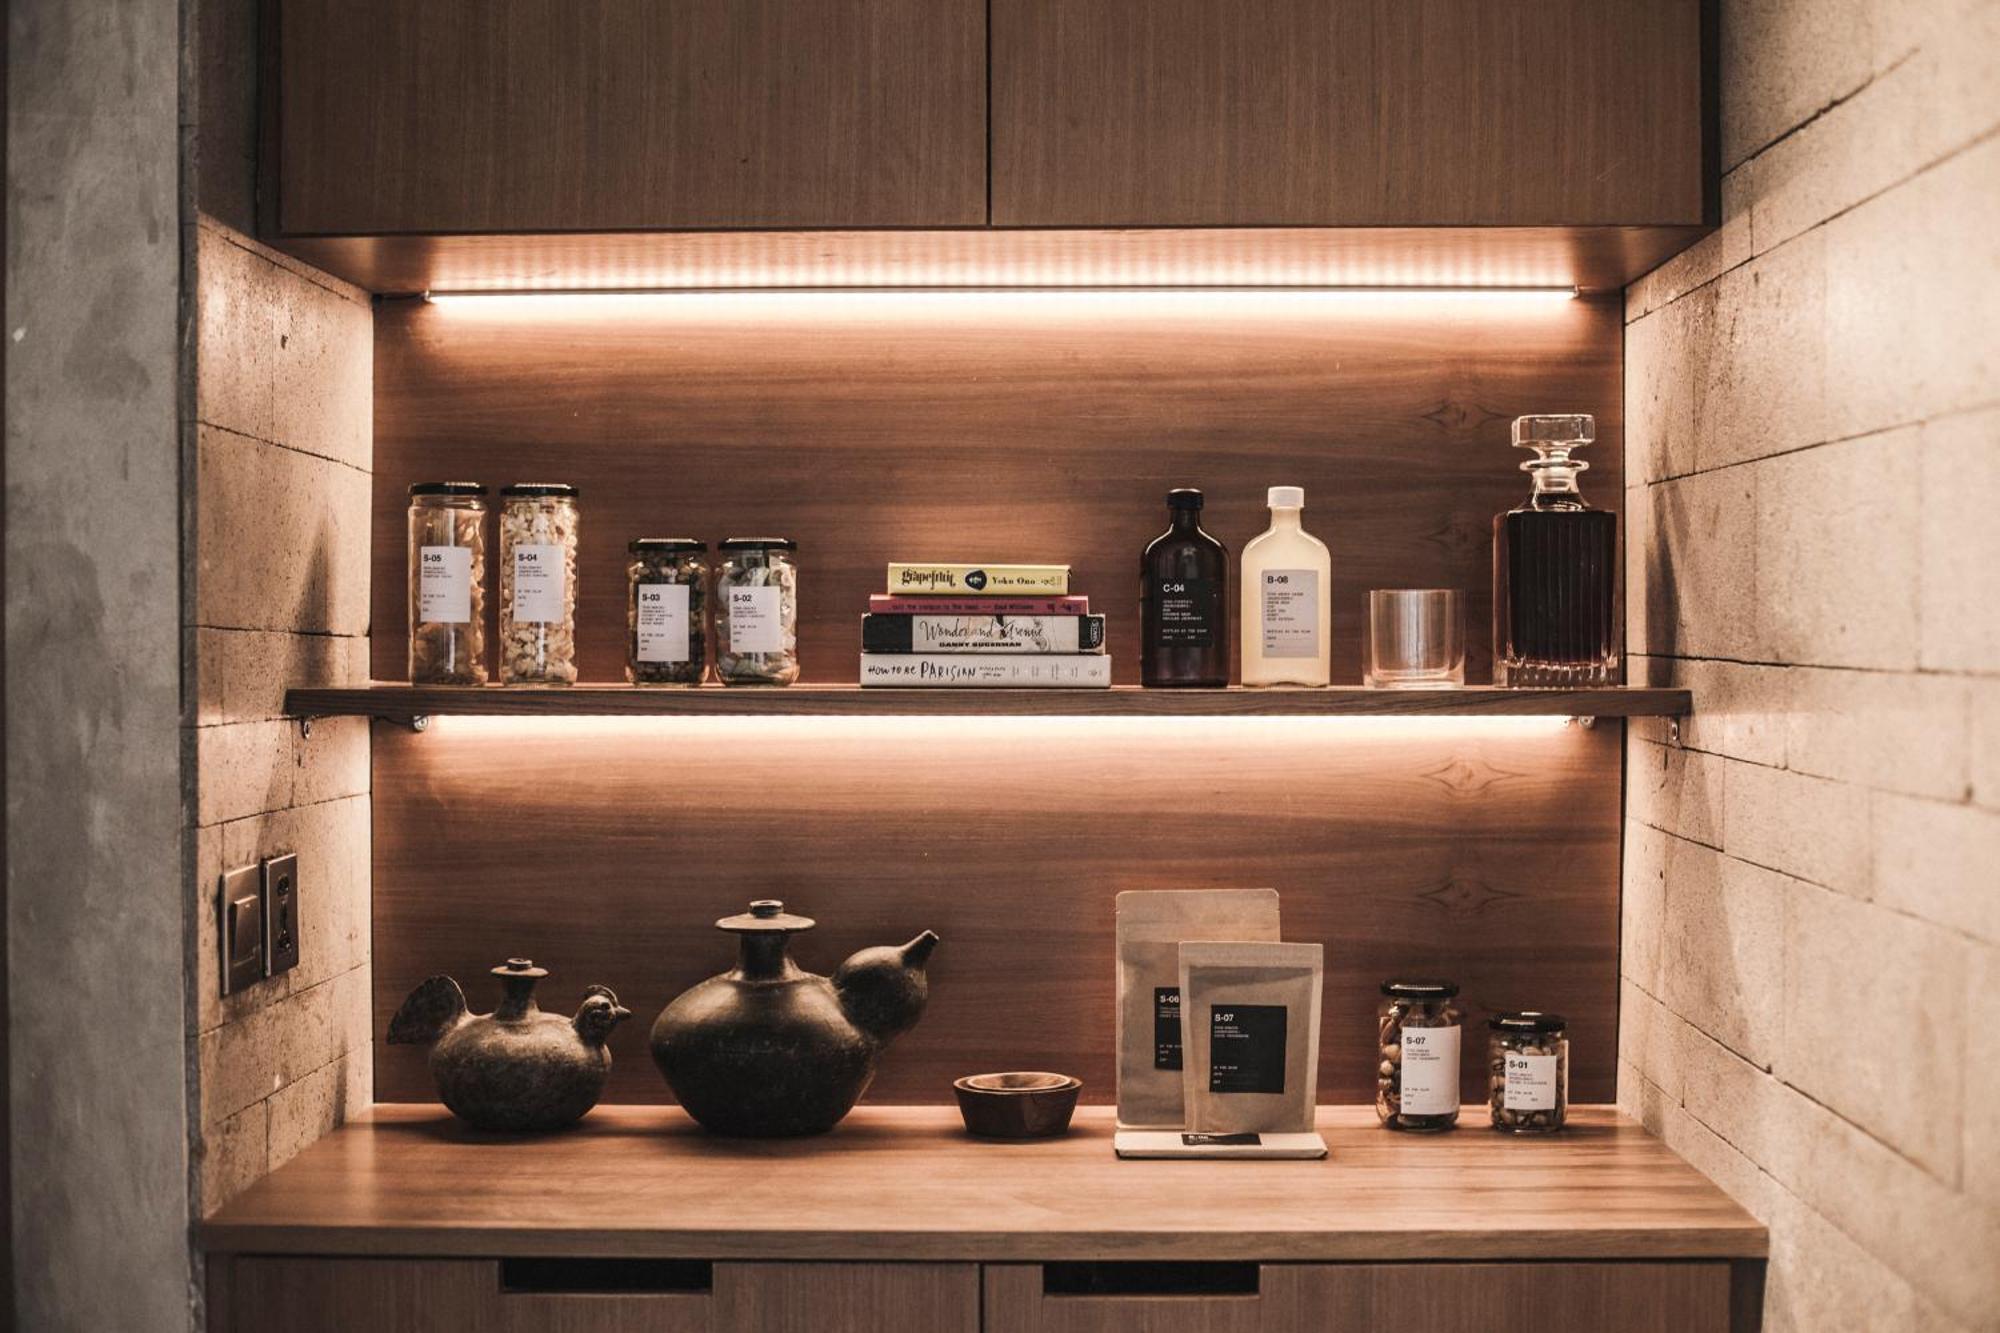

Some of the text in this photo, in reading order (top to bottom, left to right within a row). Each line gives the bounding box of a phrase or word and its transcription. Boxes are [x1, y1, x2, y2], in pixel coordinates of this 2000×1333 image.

[518, 553, 537, 562] S-04
[992, 576, 1014, 585] Yoko
[1016, 576, 1036, 585] Ono
[642, 593, 661, 602] S-03
[733, 594, 752, 602] S-02
[920, 661, 977, 681] PARISIAN
[1214, 1013, 1234, 1022] S-07
[1406, 1036, 1426, 1045] S-07
[1509, 1060, 1528, 1069] S-01
